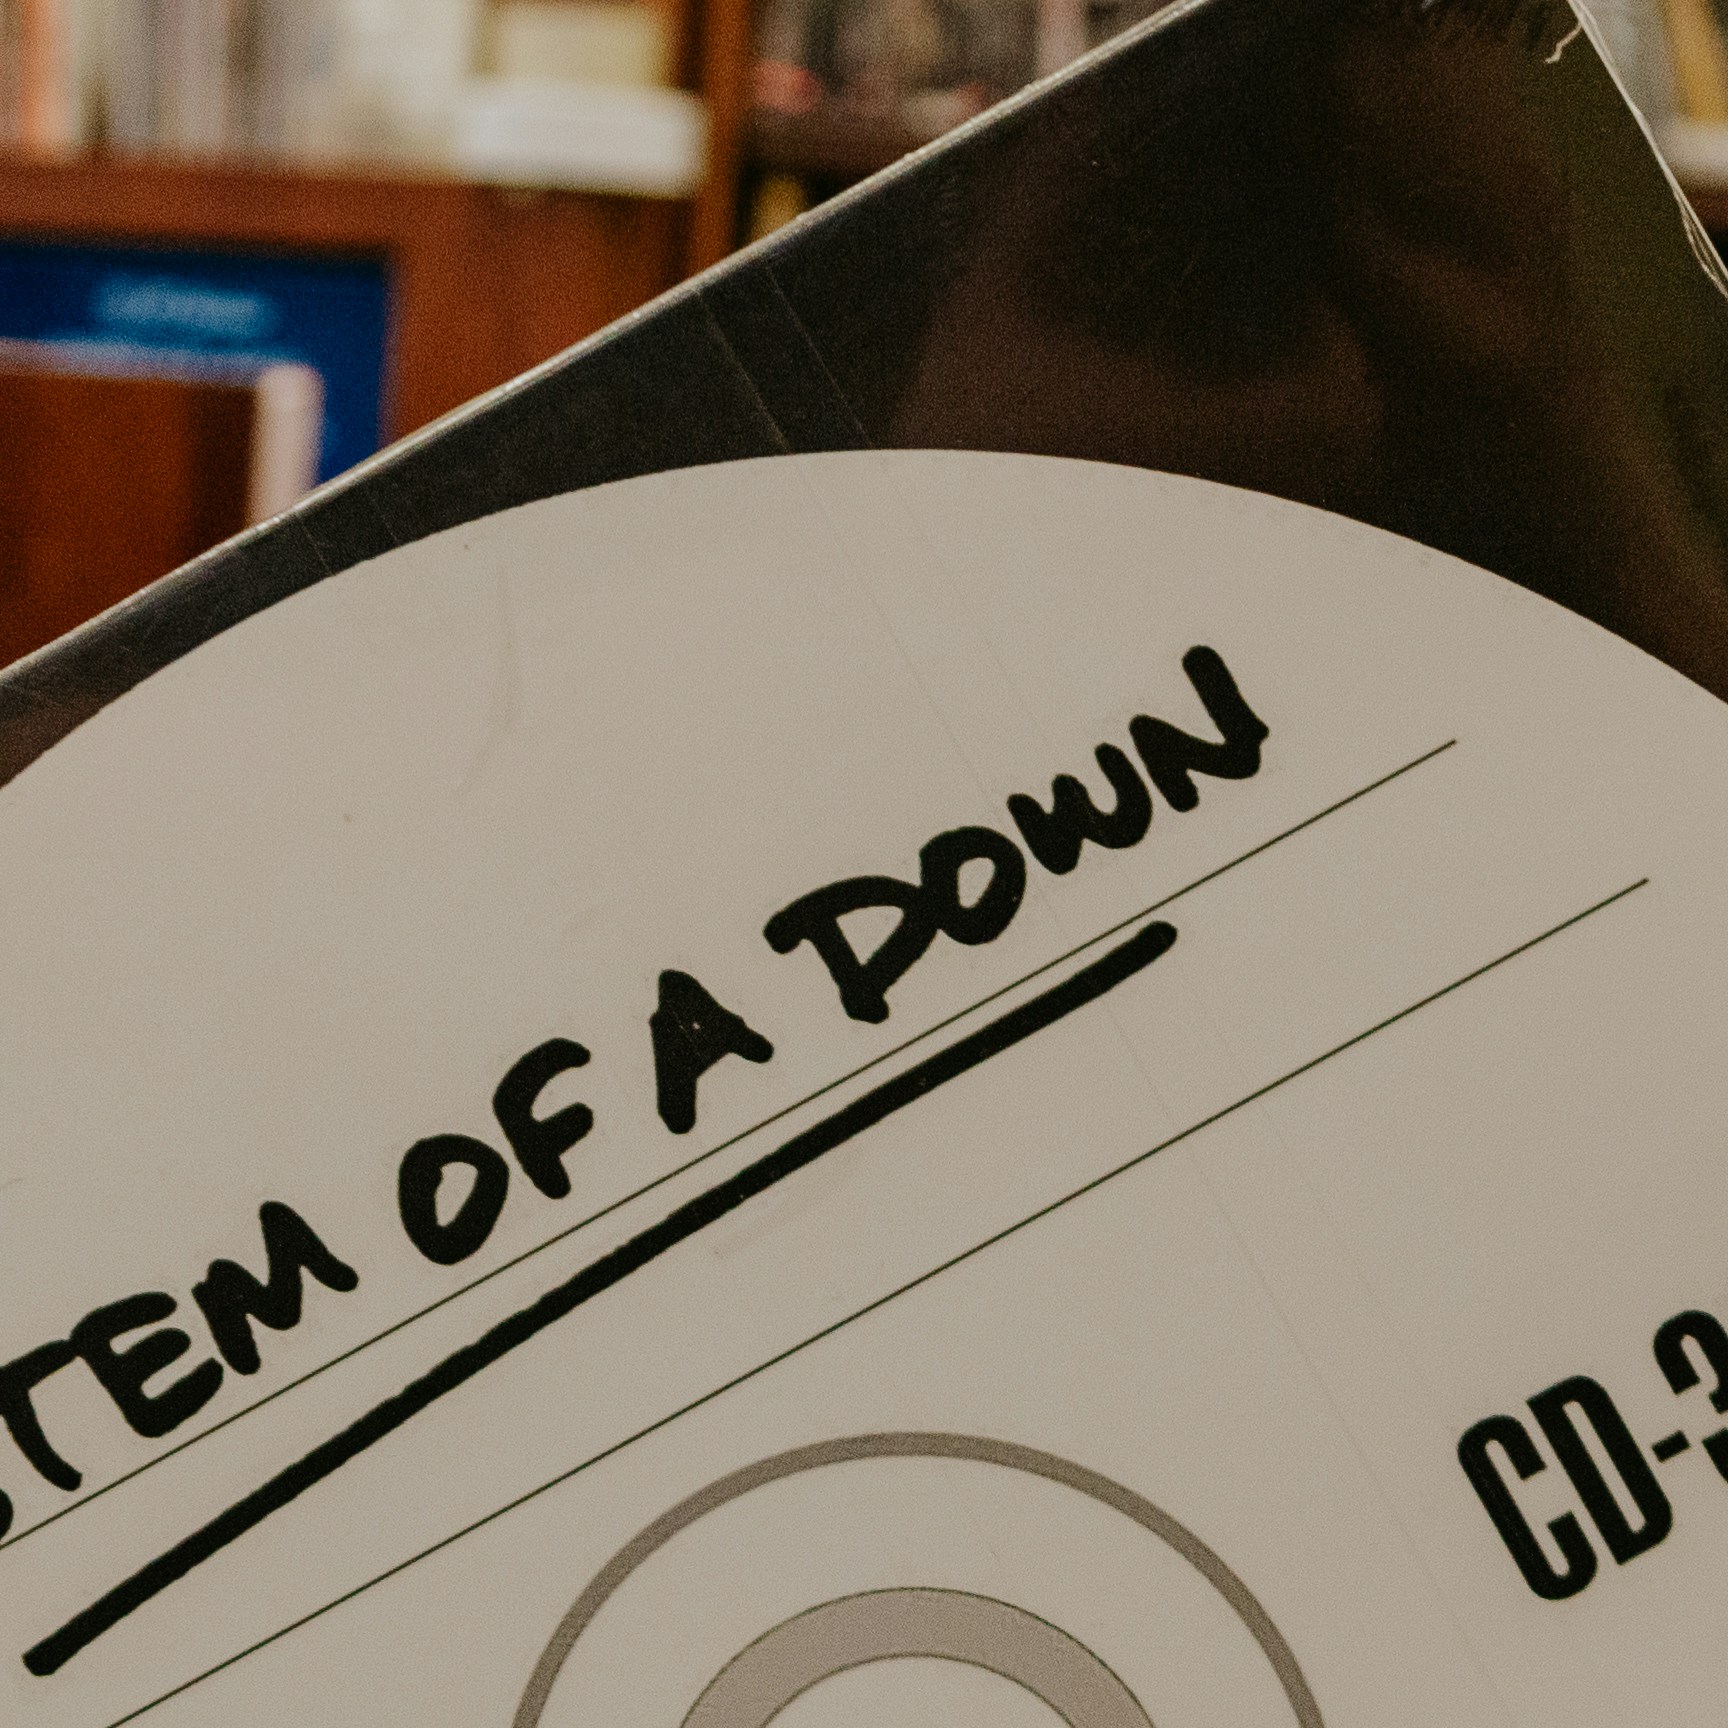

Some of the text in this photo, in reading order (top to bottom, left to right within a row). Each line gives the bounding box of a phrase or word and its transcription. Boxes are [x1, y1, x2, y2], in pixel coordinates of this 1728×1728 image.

[396, 1036, 595, 1267] OF
[647, 968, 776, 1136] A
[762, 644, 1271, 1026] DOWN
